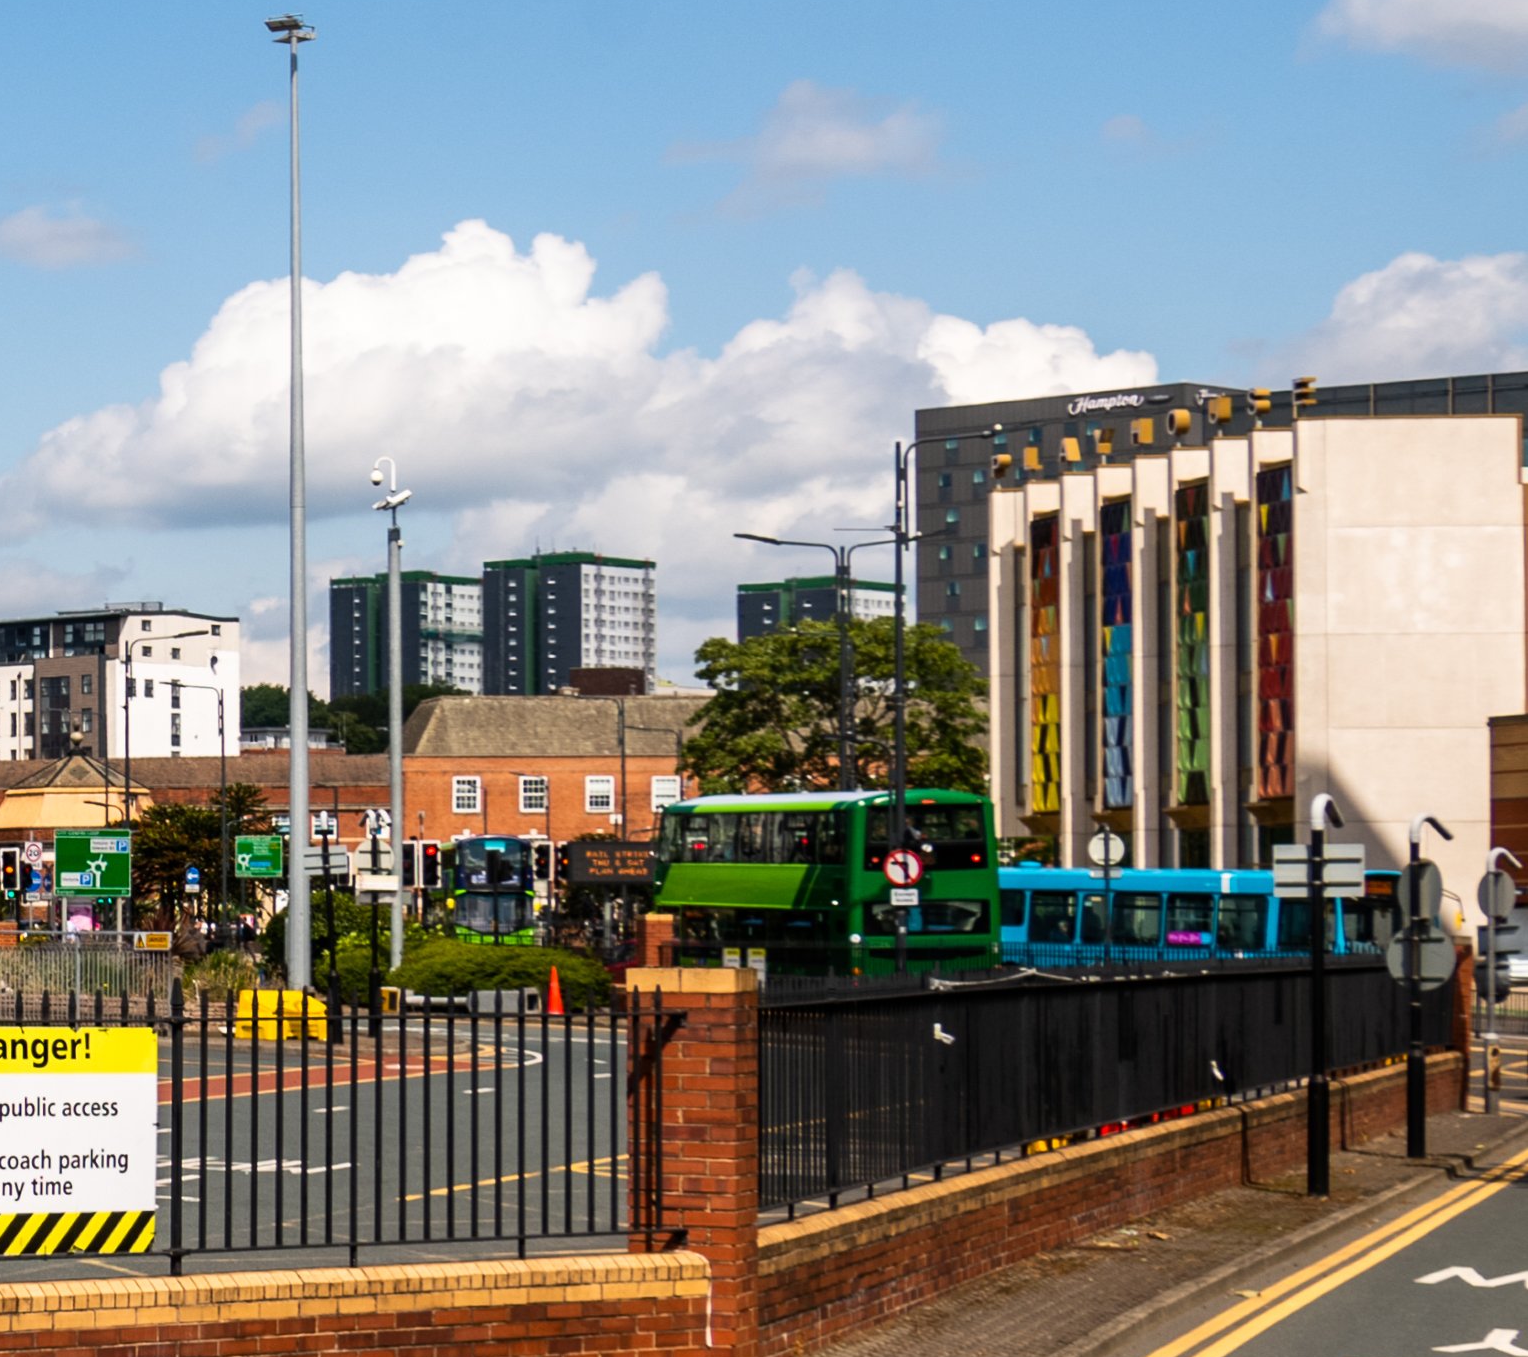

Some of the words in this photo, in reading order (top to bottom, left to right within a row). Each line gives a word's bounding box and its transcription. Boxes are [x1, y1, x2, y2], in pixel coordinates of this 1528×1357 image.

[1068, 393, 1145, 416] Hampton
[28, 849, 40, 857] 20
[61, 1100, 119, 1117] access
[58, 1148, 130, 1174] parking
[31, 1176, 74, 1197] time
